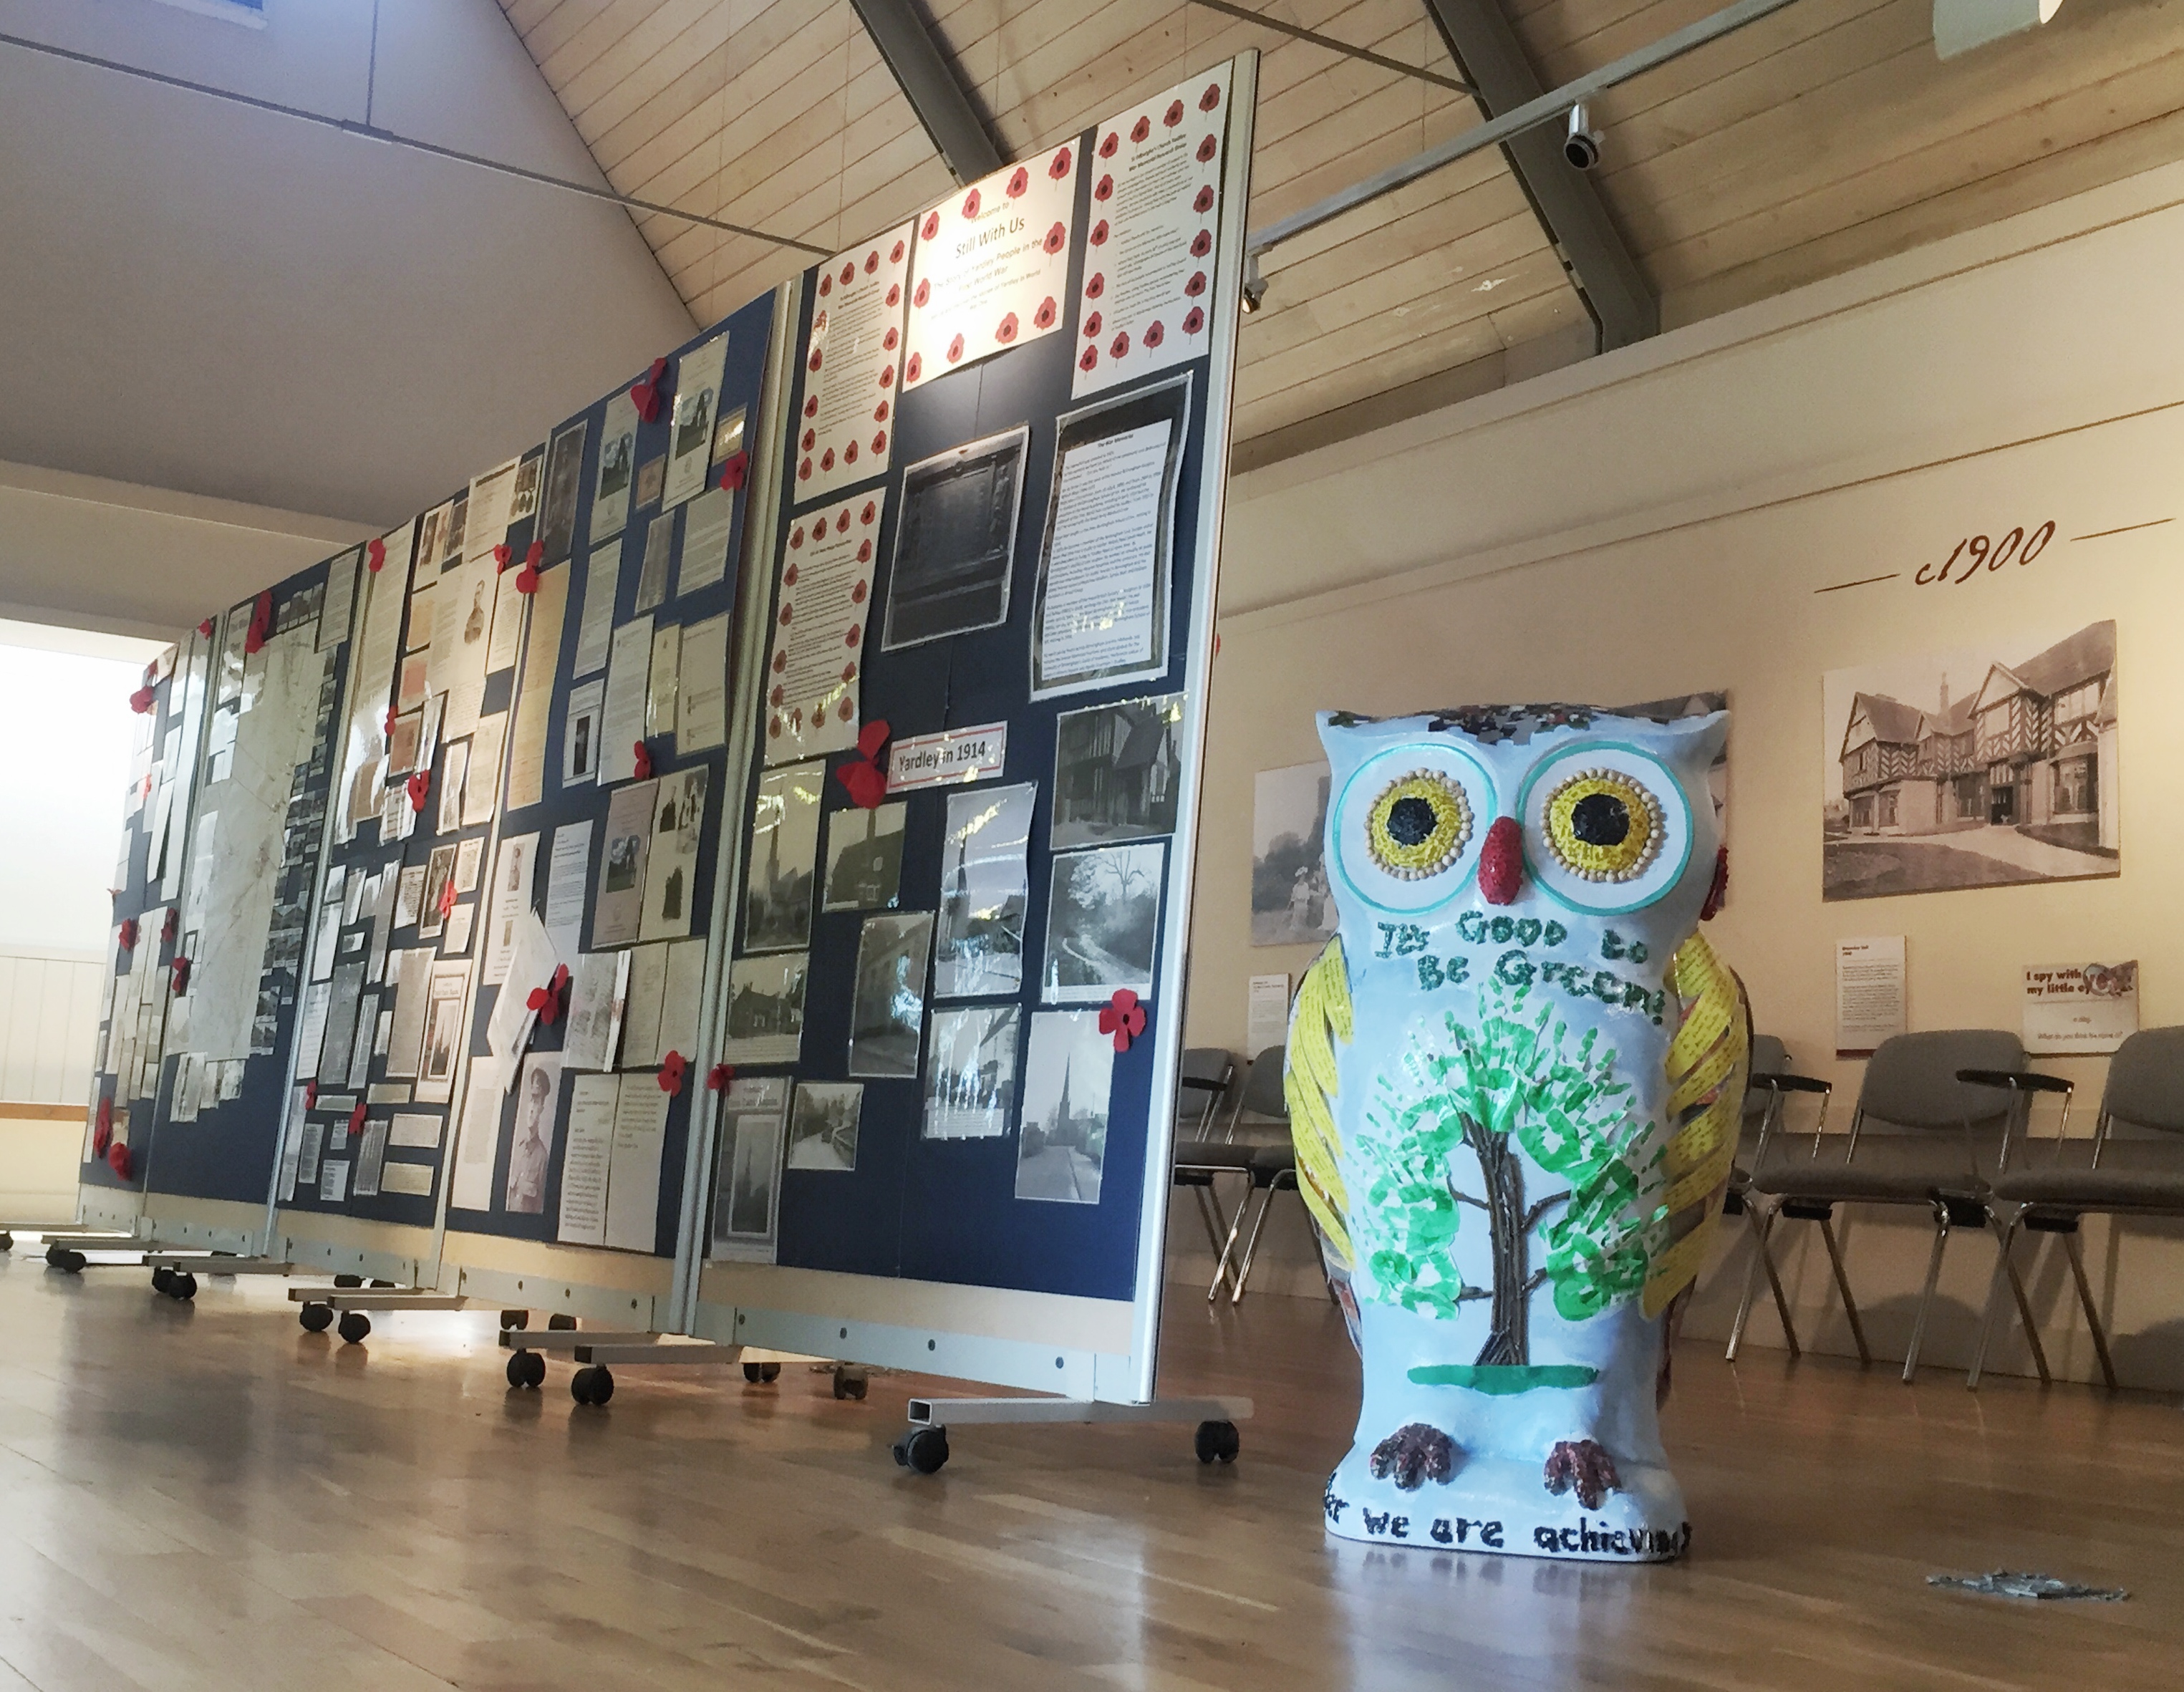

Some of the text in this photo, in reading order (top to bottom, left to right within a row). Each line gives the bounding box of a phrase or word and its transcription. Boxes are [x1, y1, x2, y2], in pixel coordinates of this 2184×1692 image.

[955, 217, 1025, 258] Still With Us
[996, 246, 1020, 261] People
[1023, 243, 1030, 252] in
[1031, 238, 1043, 248] the
[899, 740, 985, 772] Yardley in 1914
[2026, 968, 2082, 982] I spy with
[2026, 987, 2044, 996] my
[2047, 982, 2074, 993] little
[1363, 1507, 1411, 1538] we
[1430, 1517, 1504, 1548] are
